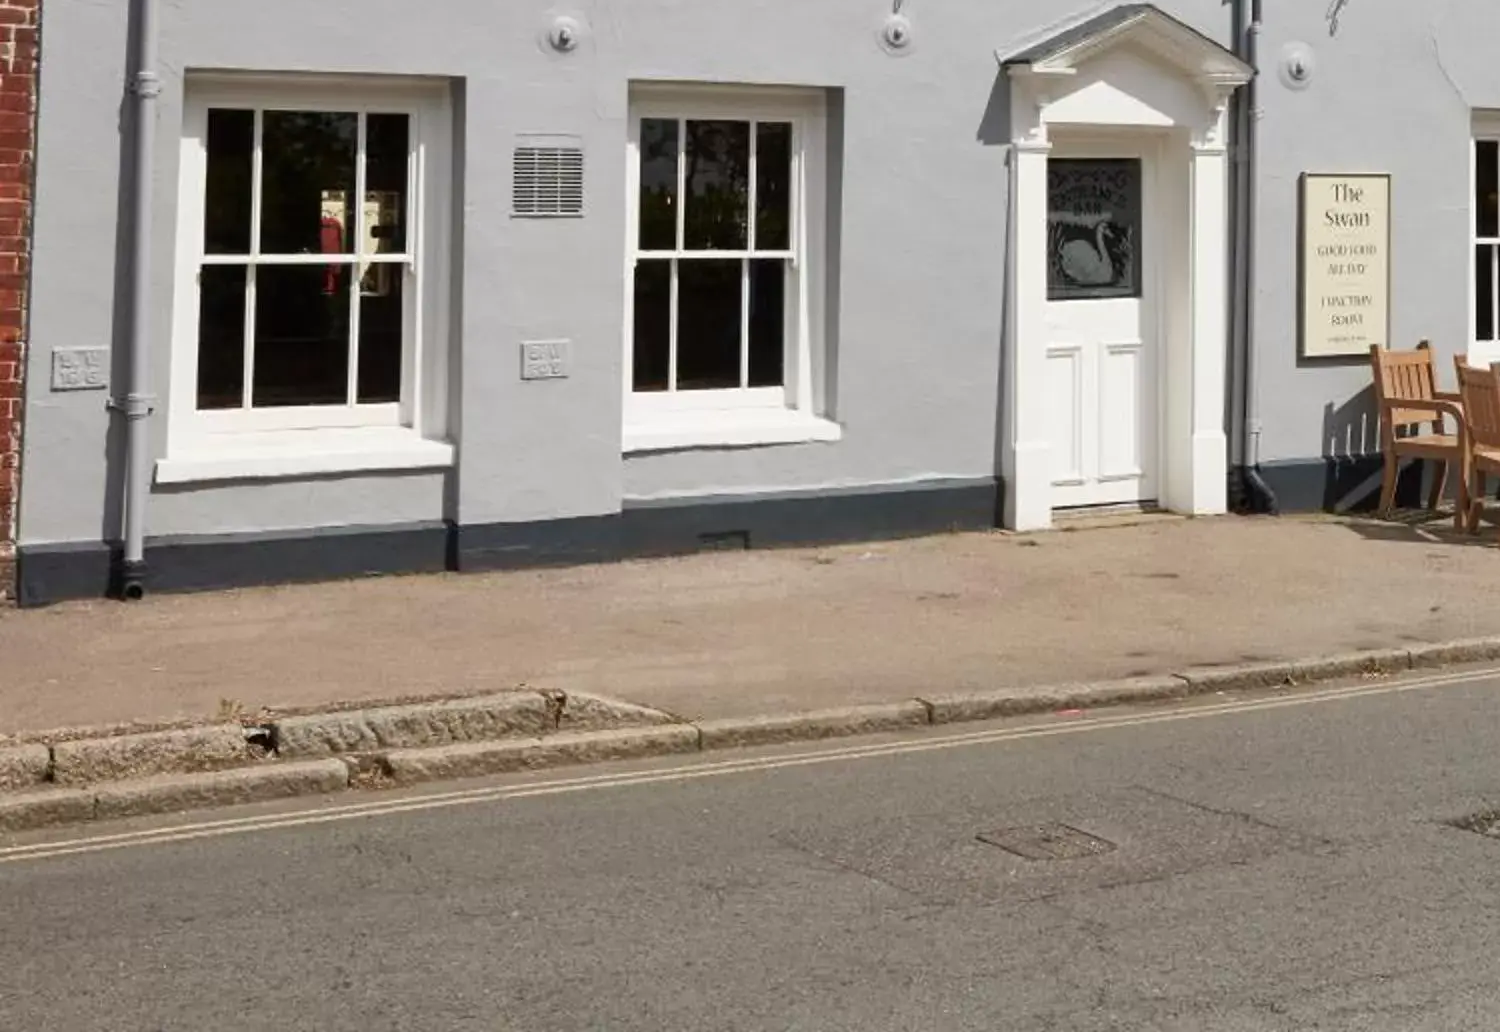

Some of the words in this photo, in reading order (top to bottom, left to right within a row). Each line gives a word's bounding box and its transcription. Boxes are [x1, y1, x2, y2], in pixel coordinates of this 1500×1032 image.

[1331, 182, 1364, 204] The
[1324, 210, 1370, 228] Swan
[1316, 245, 1347, 257] GOOD
